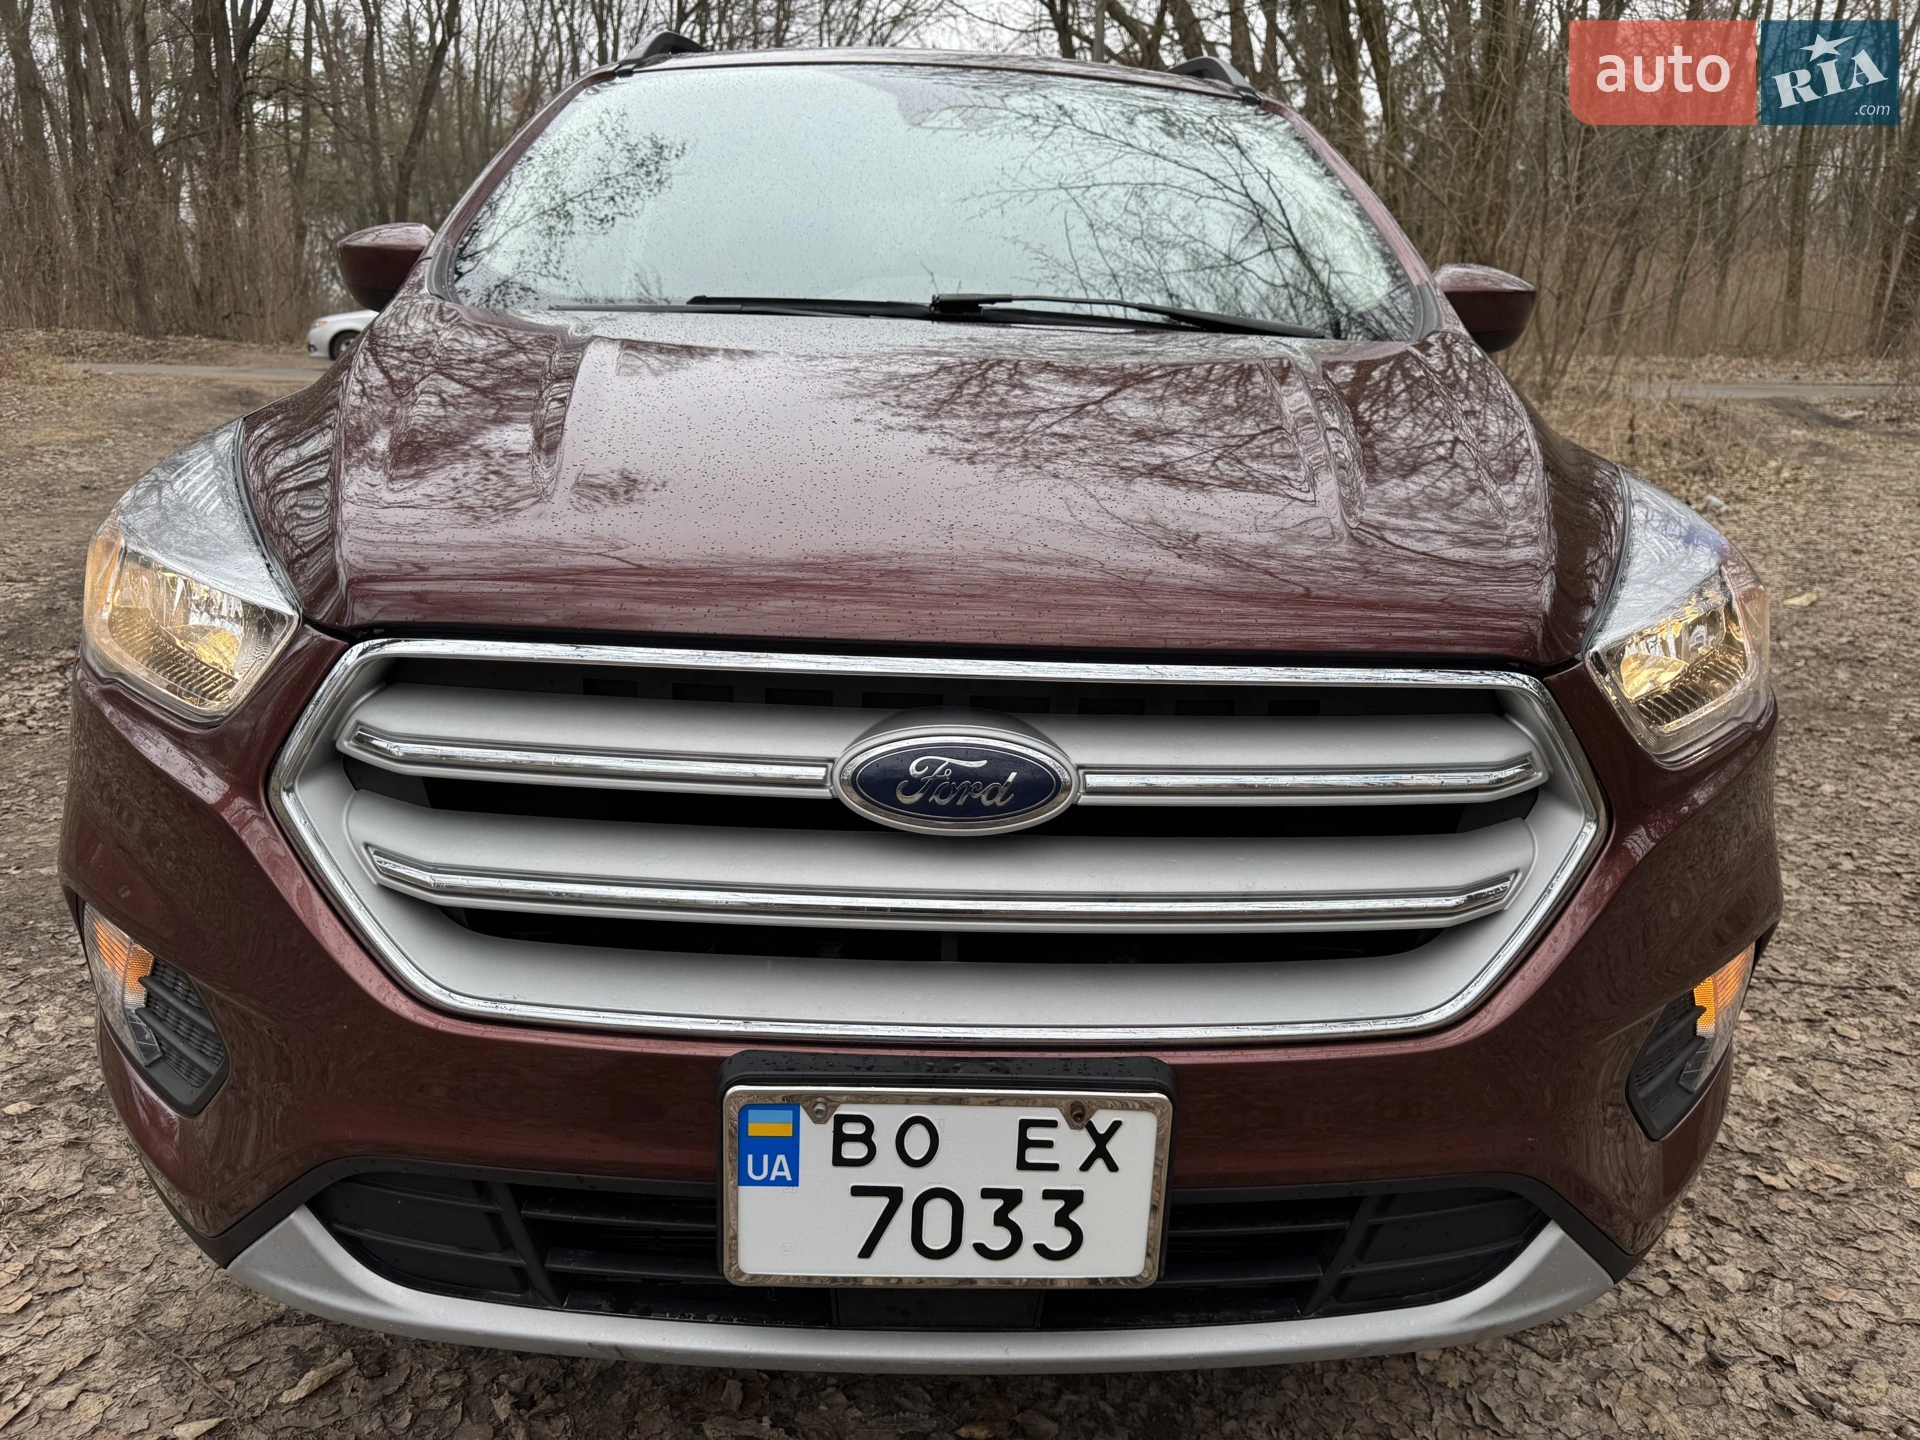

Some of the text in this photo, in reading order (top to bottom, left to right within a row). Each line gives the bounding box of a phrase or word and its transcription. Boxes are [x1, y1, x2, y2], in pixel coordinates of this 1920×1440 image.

[896, 755, 1018, 807] Ford
[747, 1154, 792, 1181] UA
[1016, 1118, 1123, 1172] EX
[850, 1185, 1085, 1261] 7033
